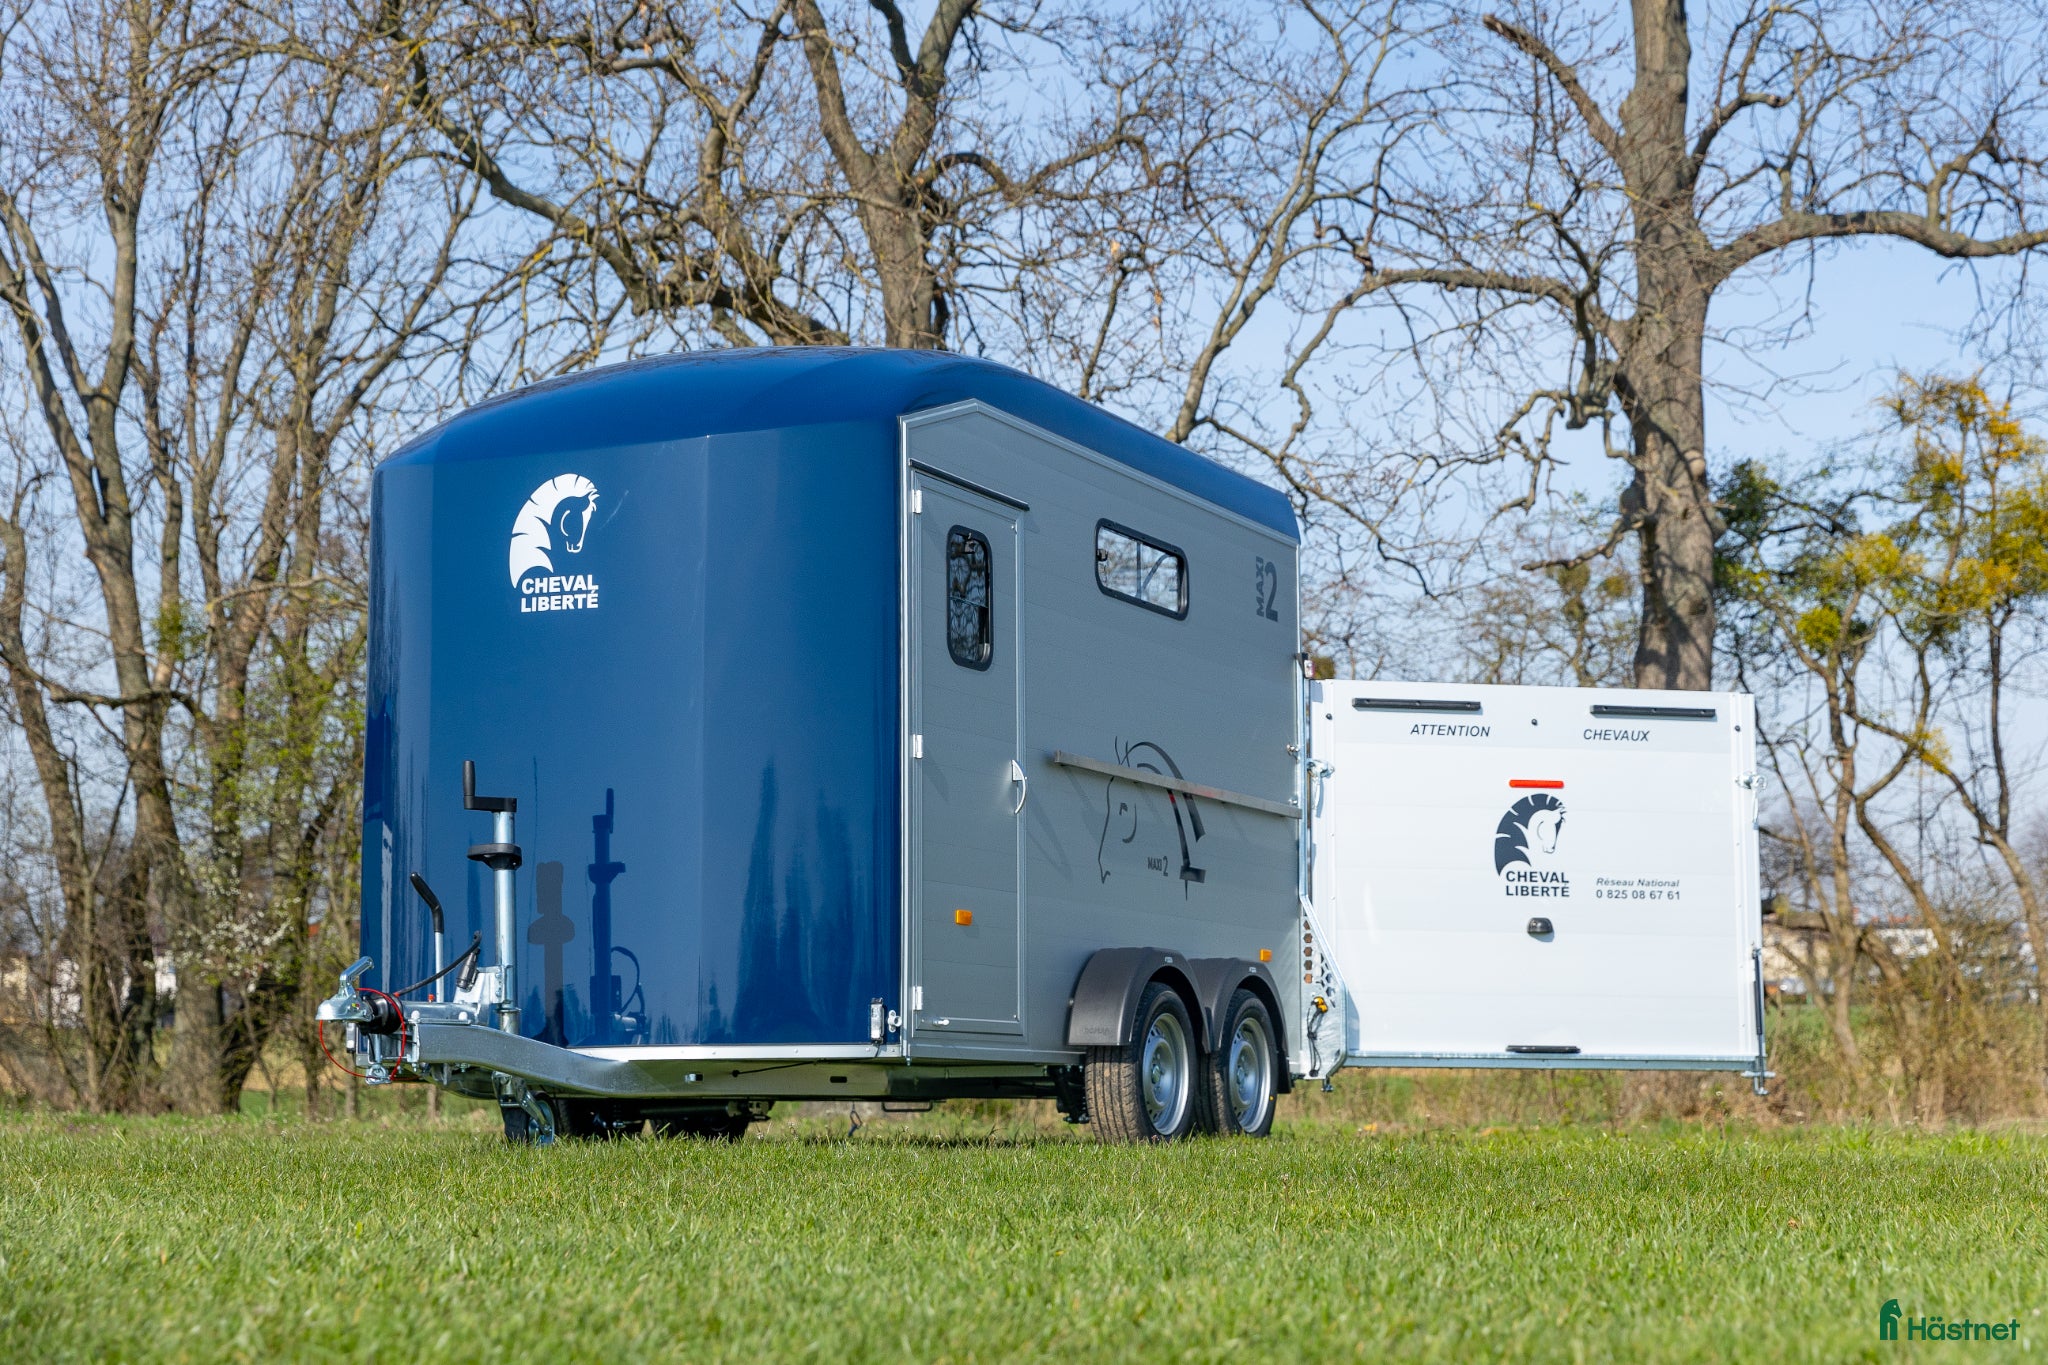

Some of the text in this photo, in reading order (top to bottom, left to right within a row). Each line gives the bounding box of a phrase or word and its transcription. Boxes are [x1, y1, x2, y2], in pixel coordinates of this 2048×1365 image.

[521, 574, 599, 595] CHEVAL
[1256, 555, 1265, 617] MAXI
[1265, 561, 1278, 622] 2
[520, 590, 599, 613] LIBERTÉ
[1410, 723, 1650, 742] ATTENTION CHEVAUX
[1162, 855, 1169, 877] 2
[1505, 870, 1570, 884] CHEVAL
[1596, 877, 1680, 887] Réseau National
[1505, 883, 1570, 898] LIBERTÉ
[1596, 889, 1680, 901] 0 825 08 67 61
